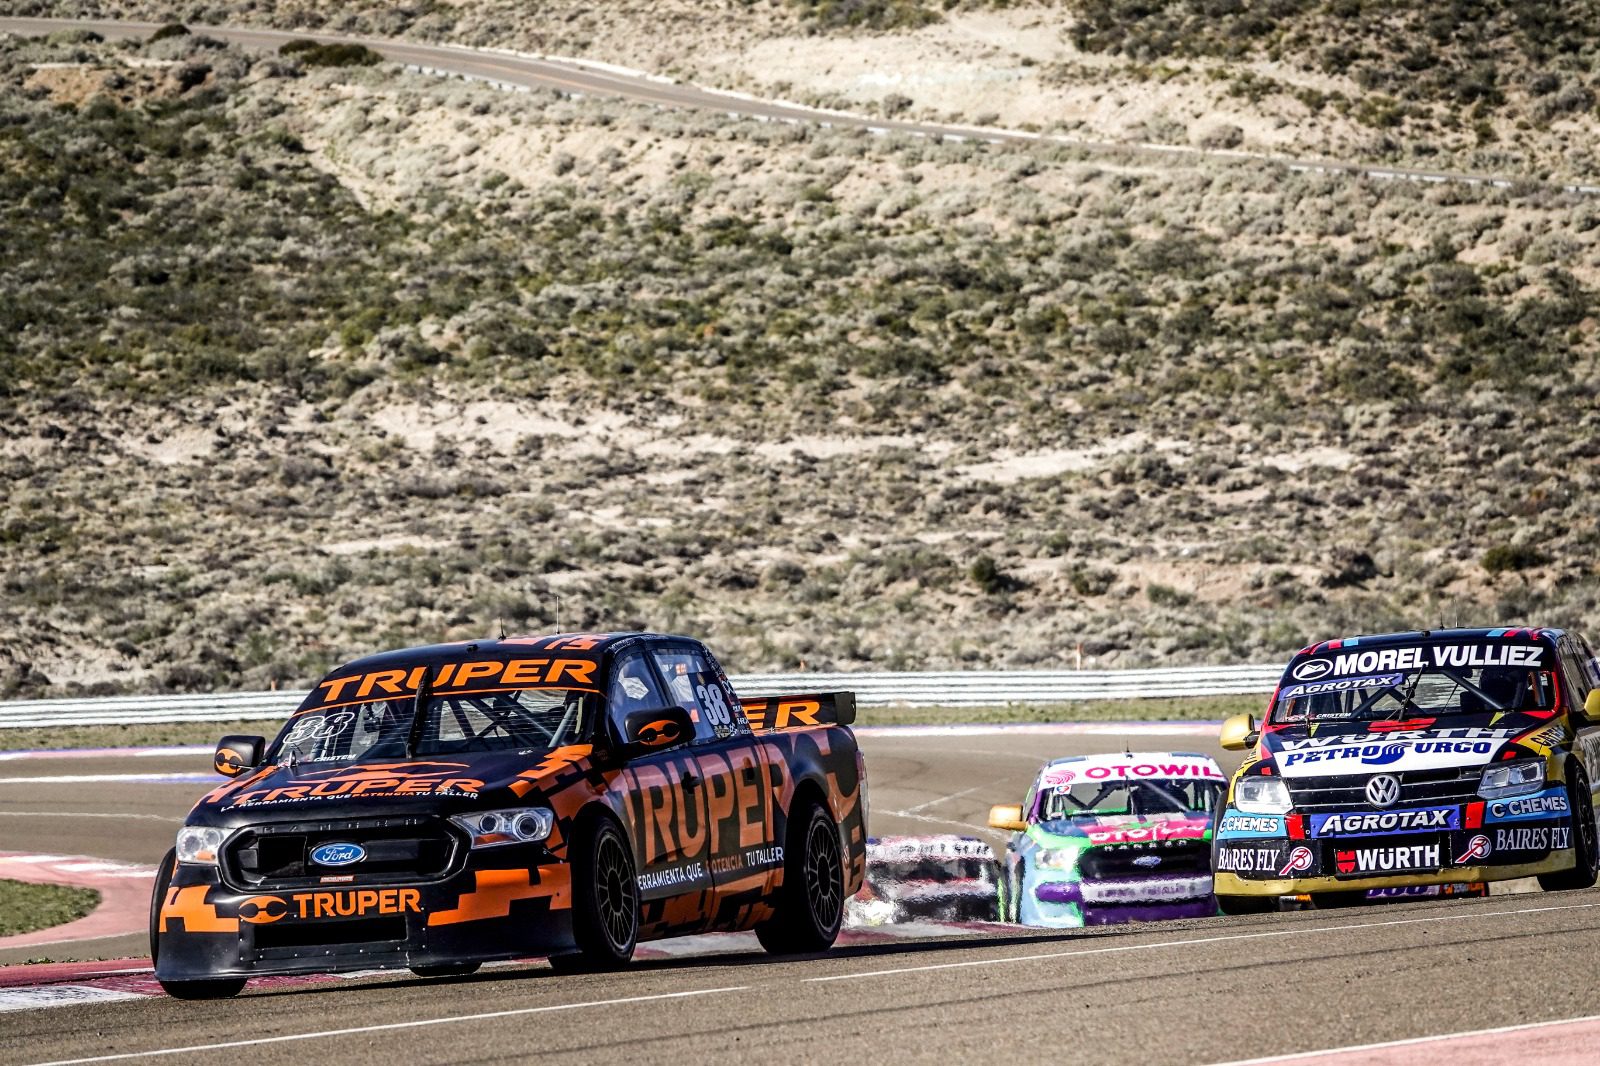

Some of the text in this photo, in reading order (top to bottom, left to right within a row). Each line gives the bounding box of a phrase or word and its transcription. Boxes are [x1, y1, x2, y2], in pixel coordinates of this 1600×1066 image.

[1333, 645, 1544, 677] MOREL VULLIEZ
[319, 659, 598, 702] TRUPER
[1286, 675, 1397, 698] AGROTAX
[696, 683, 730, 726] 38
[283, 712, 355, 744] 38
[1284, 745, 1381, 767] PETRO
[1085, 764, 1225, 780] OTOWIL
[231, 778, 486, 806] TRUPER
[434, 791, 479, 800] TALLER
[604, 742, 797, 865] TRUPER
[1508, 797, 1568, 815] CHEMES
[1227, 816, 1279, 833] CHEMES
[1318, 809, 1452, 835] AGROTAX
[1495, 827, 1570, 851] BAIRES FLY
[322, 846, 354, 861] Ford
[1217, 848, 1281, 871] BAIRES FLY
[1355, 843, 1440, 871] WÜRTH
[638, 846, 784, 890] ERRAMIENTA QUE POTENCIA TU TALLER
[292, 888, 422, 919] TRUPER
